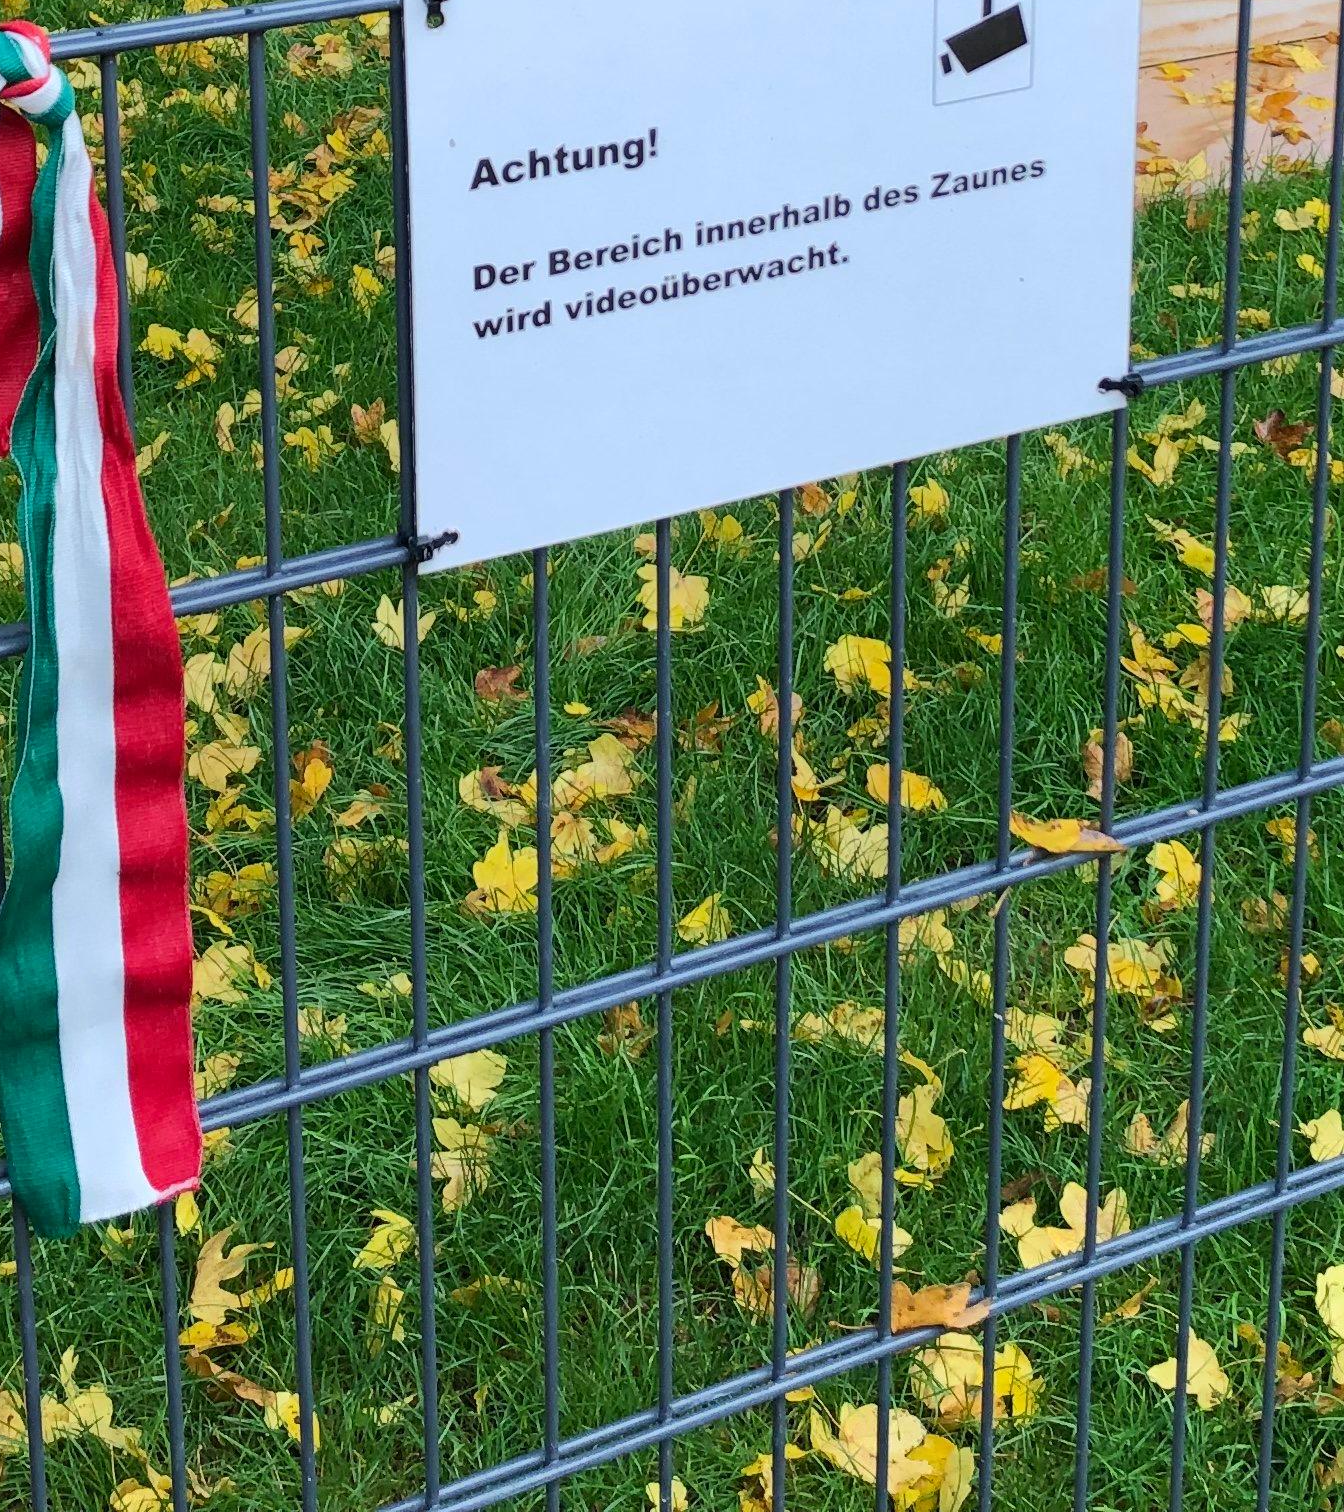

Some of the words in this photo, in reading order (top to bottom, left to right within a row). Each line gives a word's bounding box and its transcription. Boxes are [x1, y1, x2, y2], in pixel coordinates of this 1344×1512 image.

[468, 127, 659, 191] Achtung!
[472, 258, 536, 292] Der
[547, 227, 683, 277] Bereich
[695, 194, 852, 248] innerhalb
[862, 184, 920, 213] des
[929, 158, 1047, 200] Zaunes
[472, 299, 553, 340] wird
[564, 242, 851, 321] videoüberwacht.
